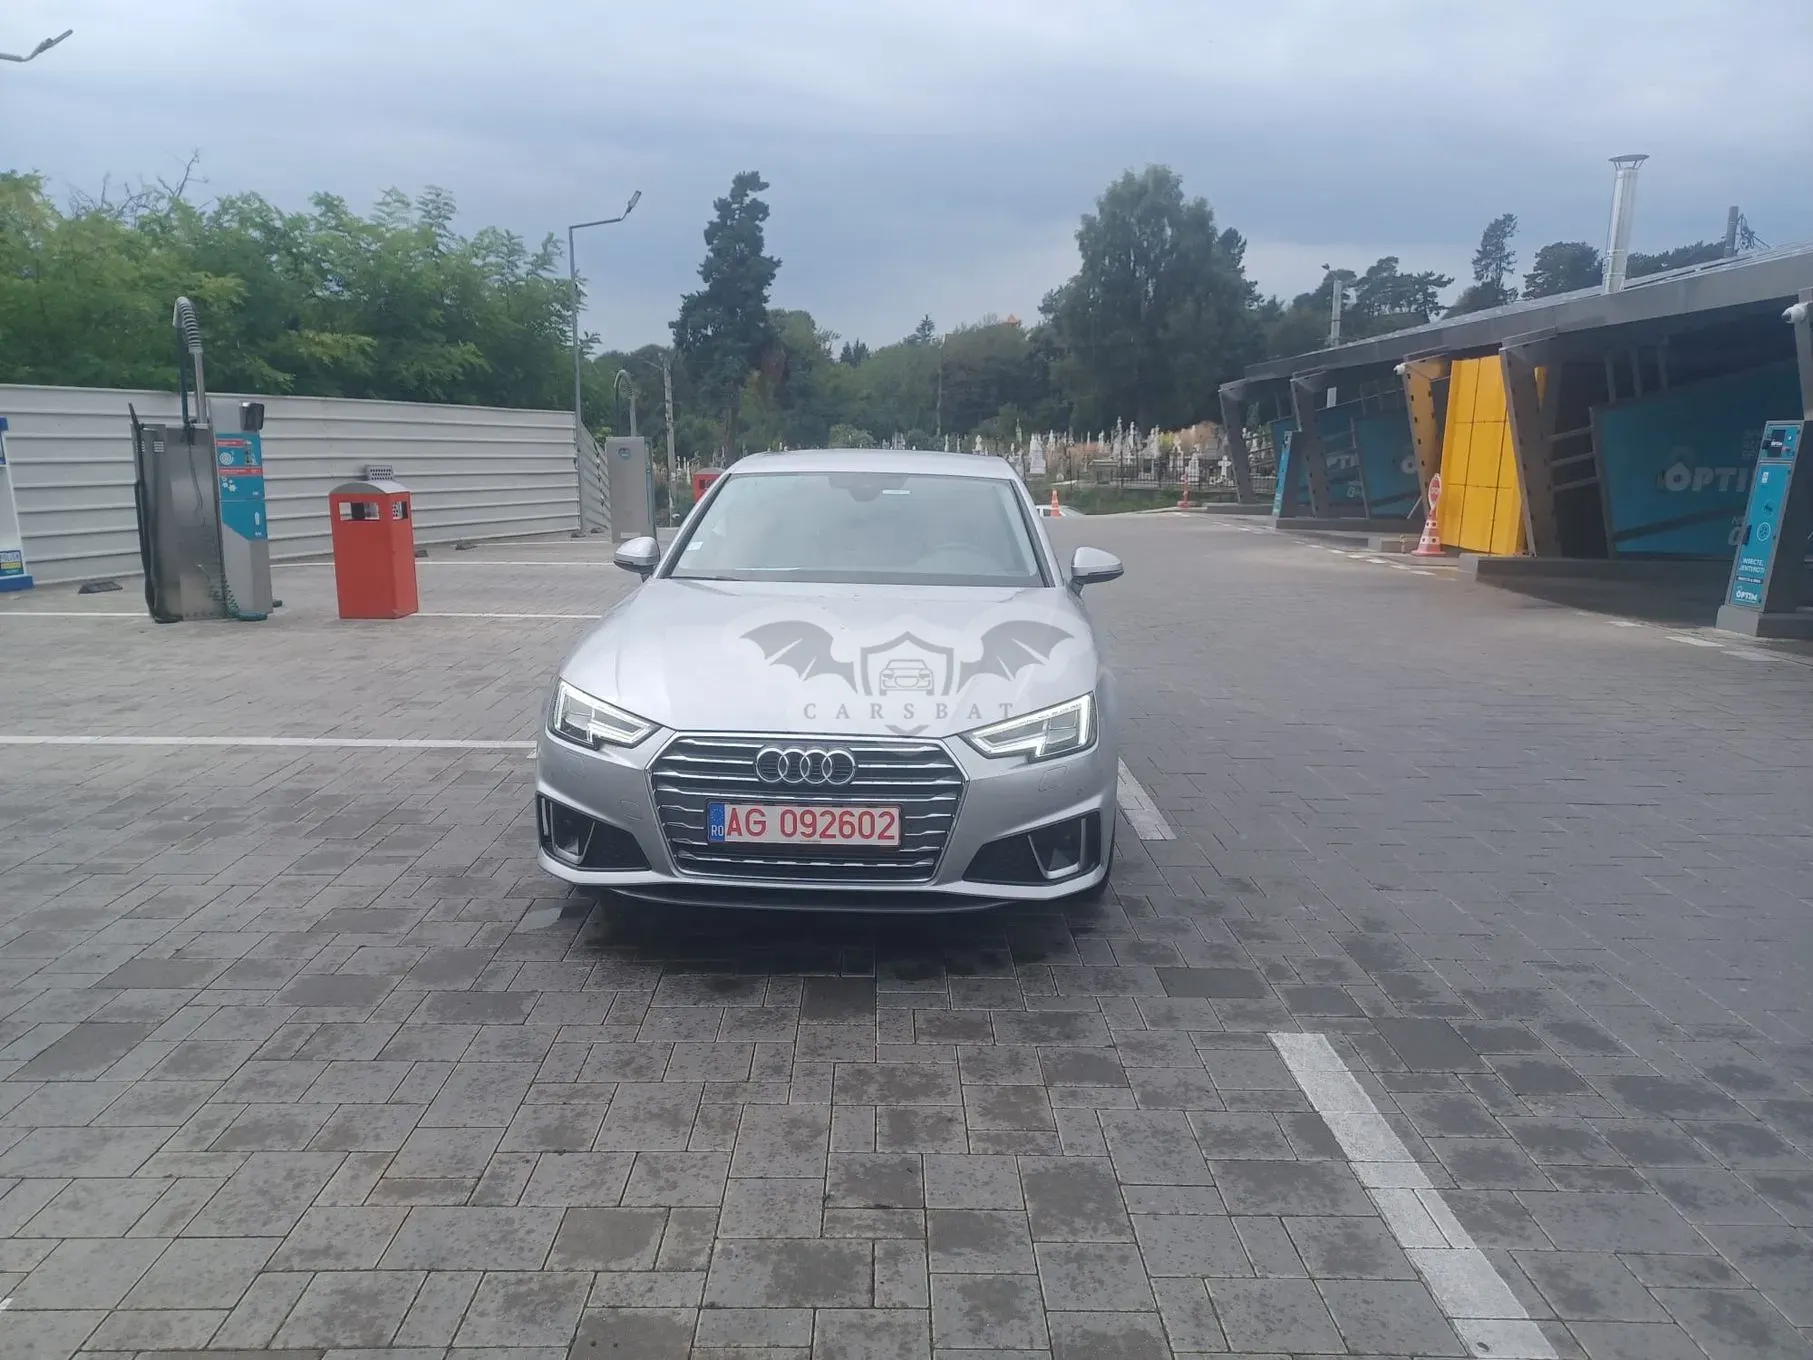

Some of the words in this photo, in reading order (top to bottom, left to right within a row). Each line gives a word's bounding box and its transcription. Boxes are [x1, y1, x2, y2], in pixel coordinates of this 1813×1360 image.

[1664, 461, 1749, 492] OPTI
[711, 825, 724, 836] RO
[726, 807, 767, 837] AG
[779, 809, 896, 840] 092602
